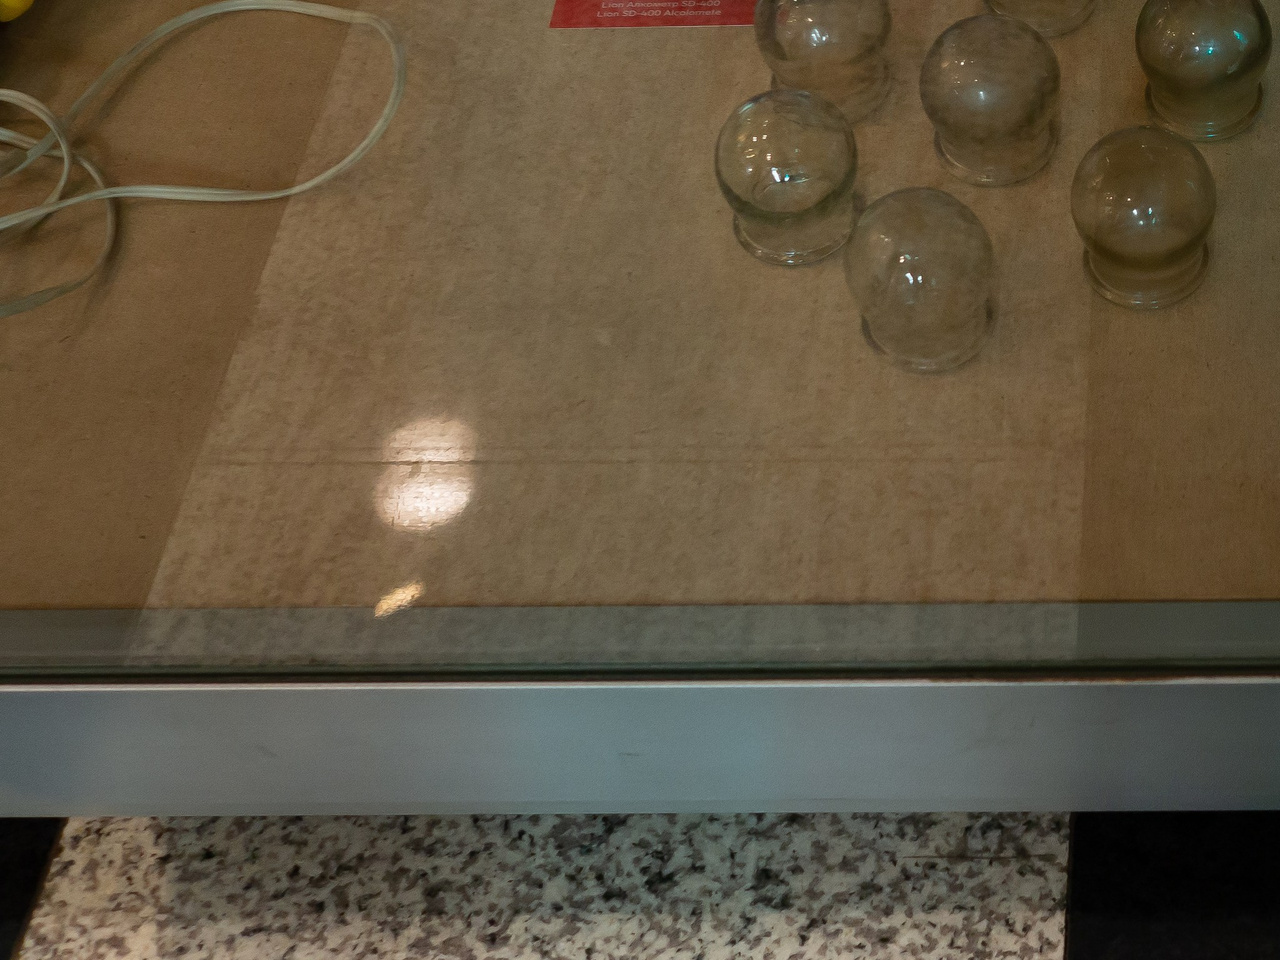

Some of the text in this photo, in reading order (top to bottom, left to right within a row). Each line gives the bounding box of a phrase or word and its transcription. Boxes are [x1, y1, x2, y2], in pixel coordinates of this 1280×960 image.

[601, 0, 721, 10] Lion Алкометр SD-400
[596, 10, 620, 18] Lion
[621, 9, 662, 17] SD-400
